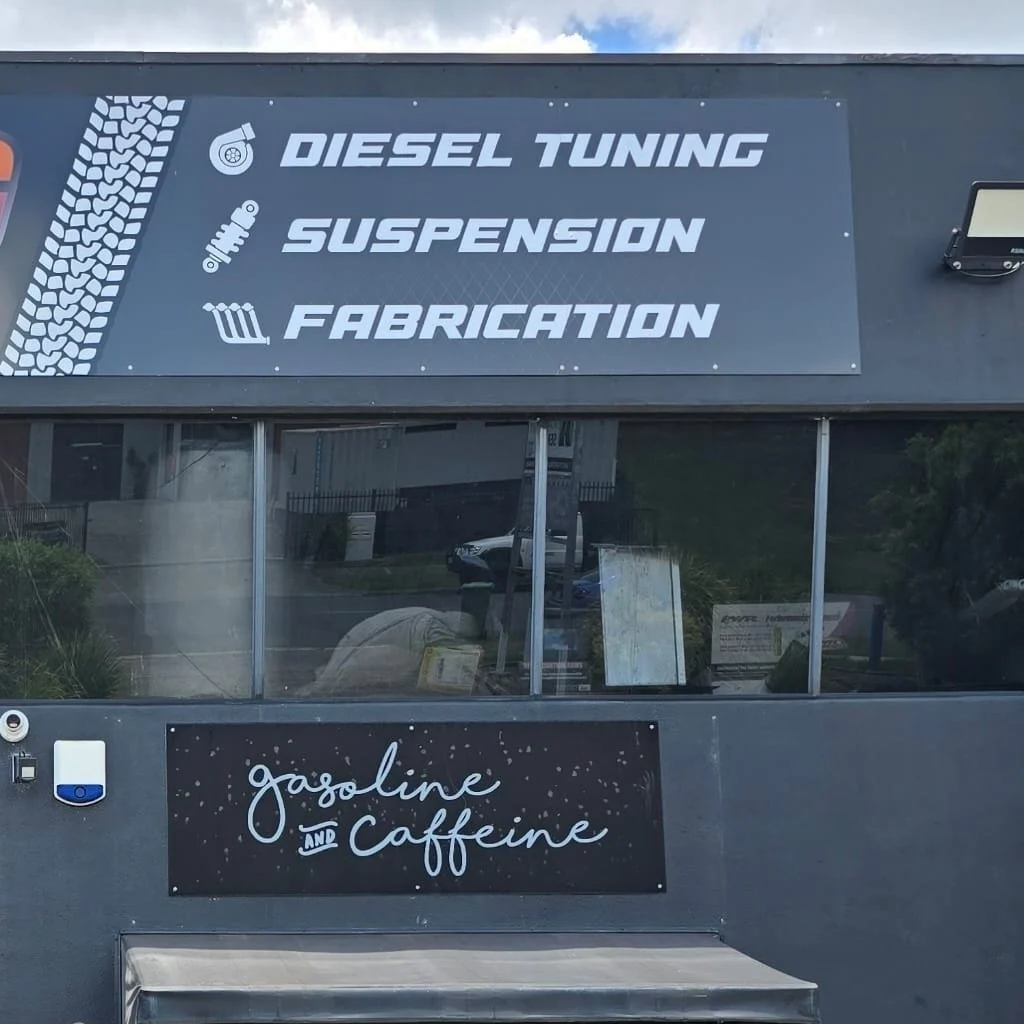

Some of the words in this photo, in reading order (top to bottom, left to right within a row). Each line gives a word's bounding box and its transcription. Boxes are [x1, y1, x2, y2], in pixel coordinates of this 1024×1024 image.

[279, 133, 512, 167] DIESEL
[533, 133, 769, 167] TUNING
[281, 217, 706, 252] SUSPENSION
[283, 303, 720, 339] FABRICATION
[248, 741, 501, 843] gasoline
[302, 827, 337, 851] AND
[349, 808, 608, 876] Caffeine
